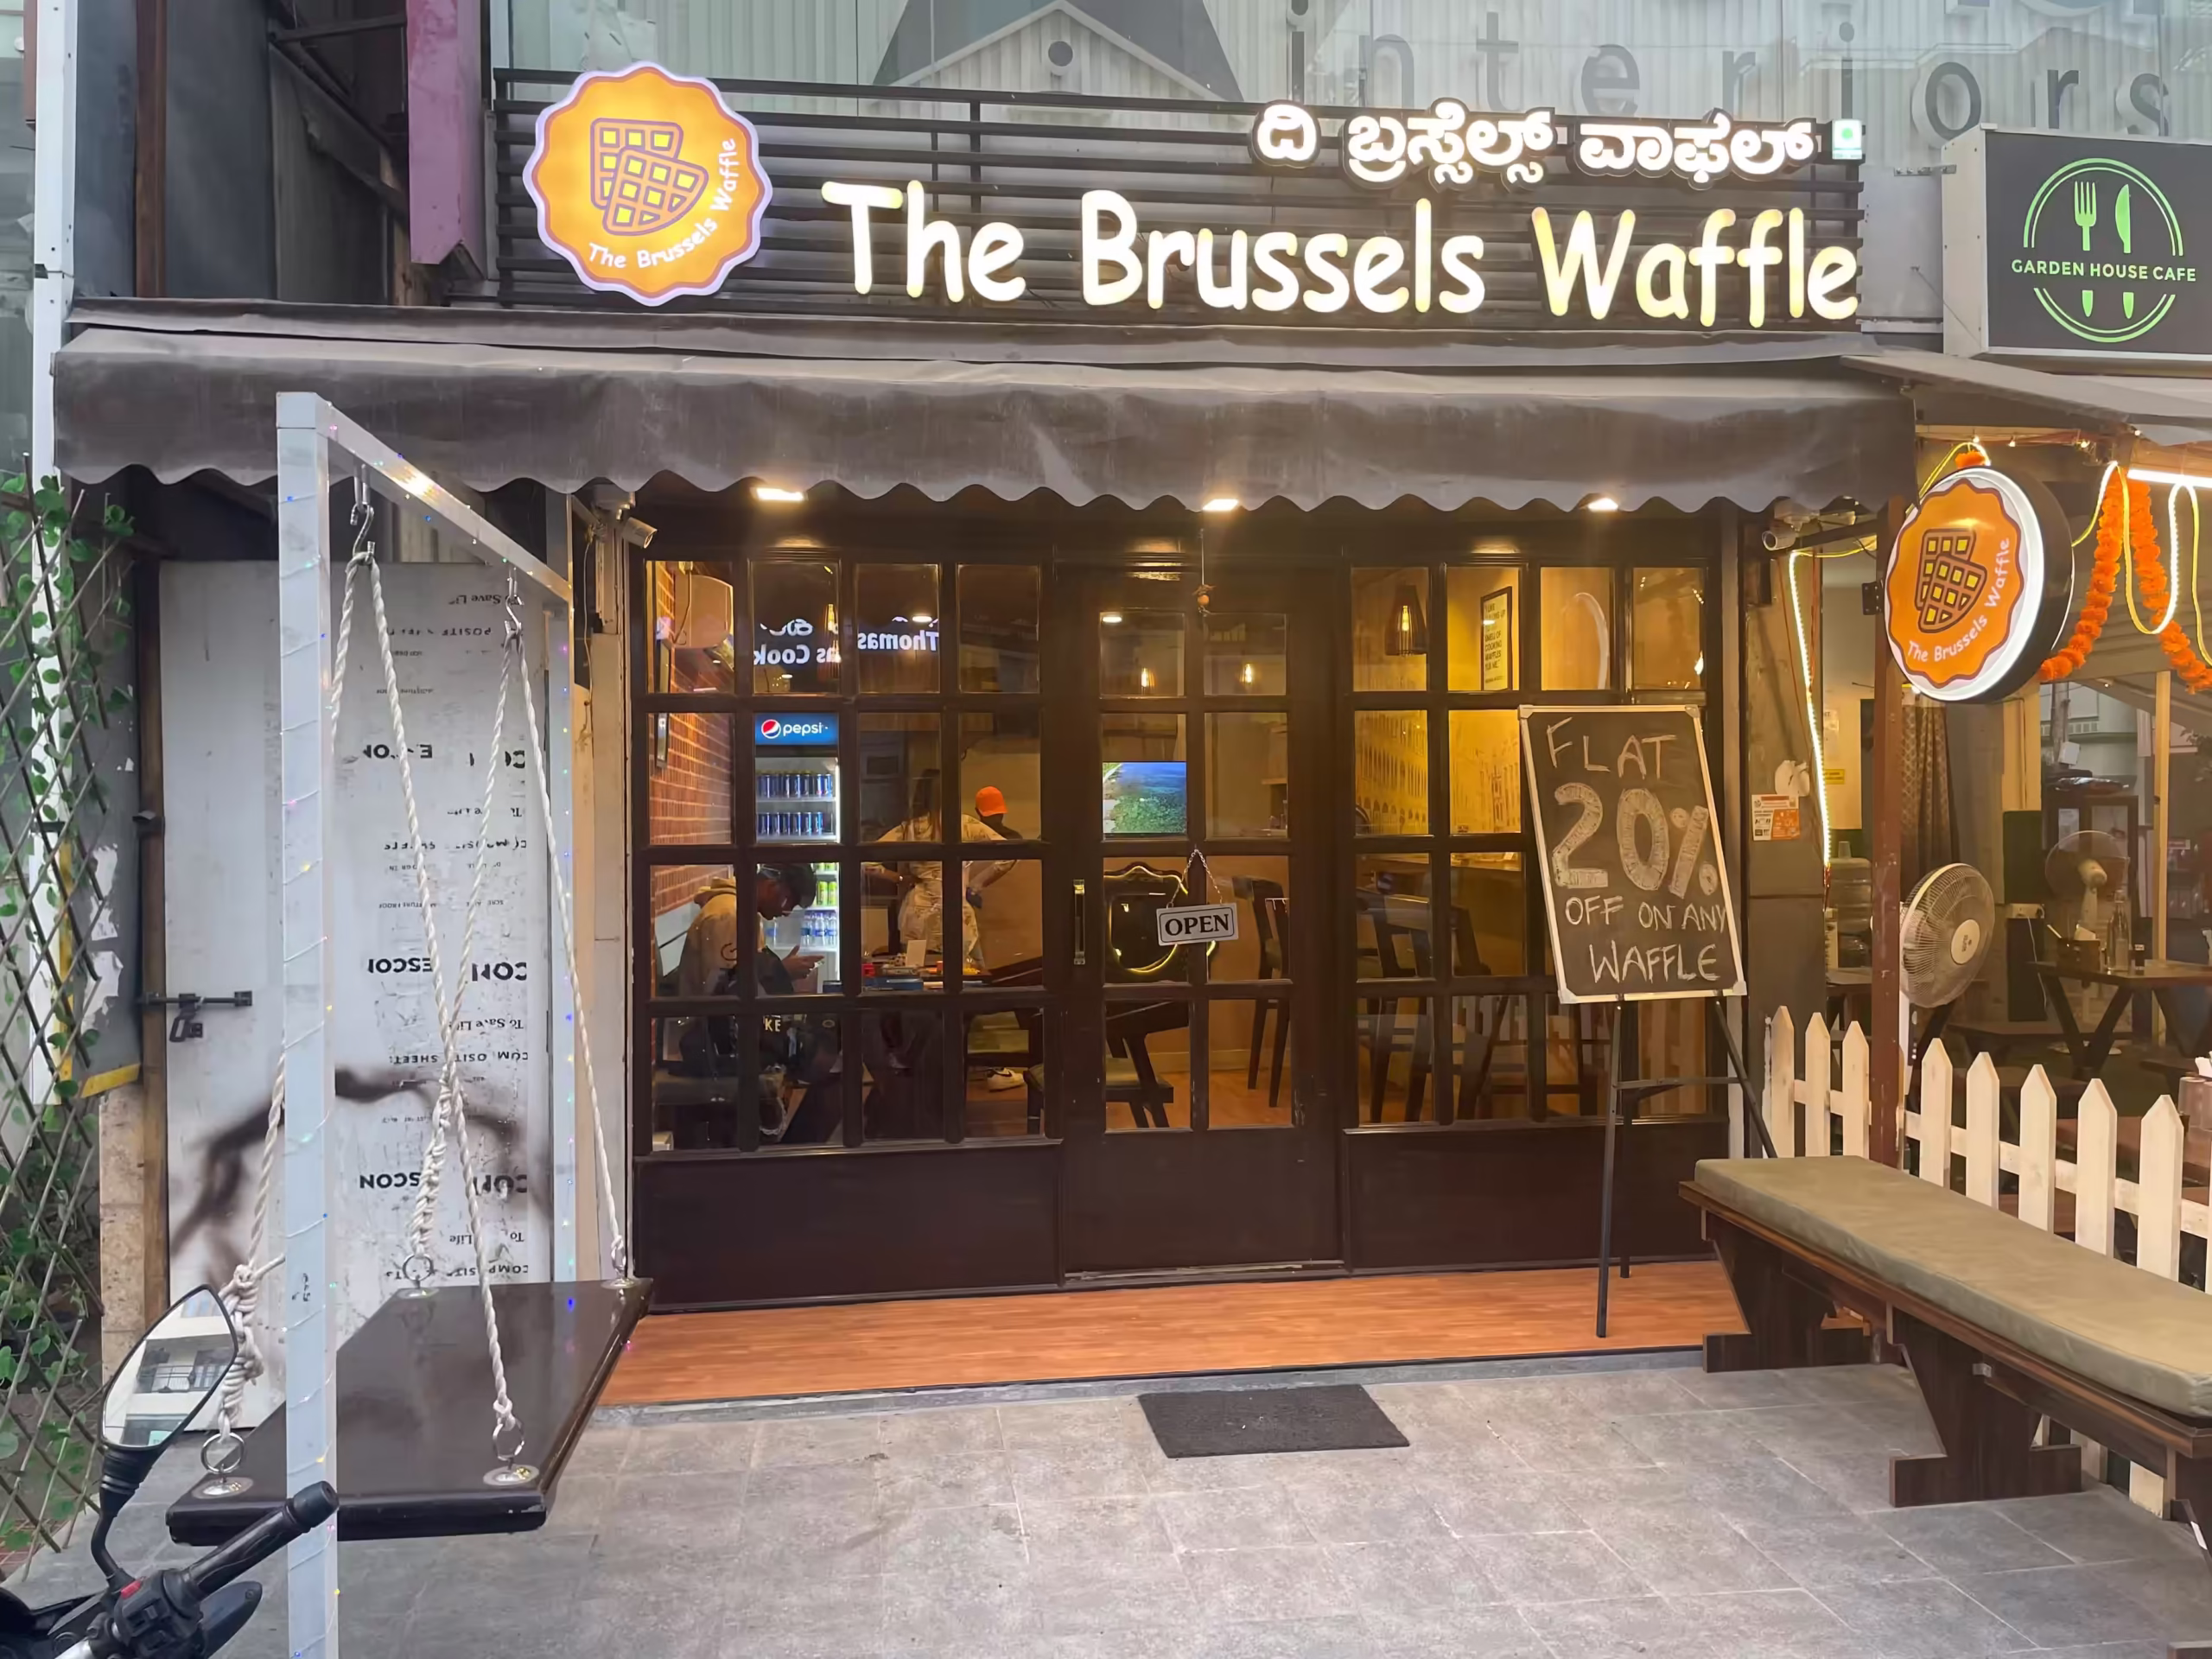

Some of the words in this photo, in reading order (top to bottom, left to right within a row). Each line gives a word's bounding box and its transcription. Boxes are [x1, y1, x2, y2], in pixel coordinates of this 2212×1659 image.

[1256, 103, 1317, 162] ದಿ
[588, 243, 626, 269] The
[637, 216, 718, 269] Brussels
[710, 138, 739, 212] Waffle
[821, 180, 1027, 302] The
[1082, 189, 1484, 314] Brussels
[1531, 206, 1858, 328] Waffle
[2011, 259, 2085, 276] GARDEN
[2089, 263, 2148, 279] HOUSE
[2152, 266, 2196, 282] CAFE
[1907, 639, 1929, 663] The
[1934, 614, 1987, 663] Brussels
[1984, 537, 2010, 608] Waffle
[783, 722, 823, 736] pepsi
[1546, 716, 1677, 780] FLAT
[1552, 782, 1719, 899] 20%
[1165, 913, 1230, 937] OPEN
[1565, 895, 1624, 925] OFF
[1638, 901, 1676, 931] ON
[1681, 902, 1726, 934] ANY
[1589, 939, 1720, 984] WAFFLE
